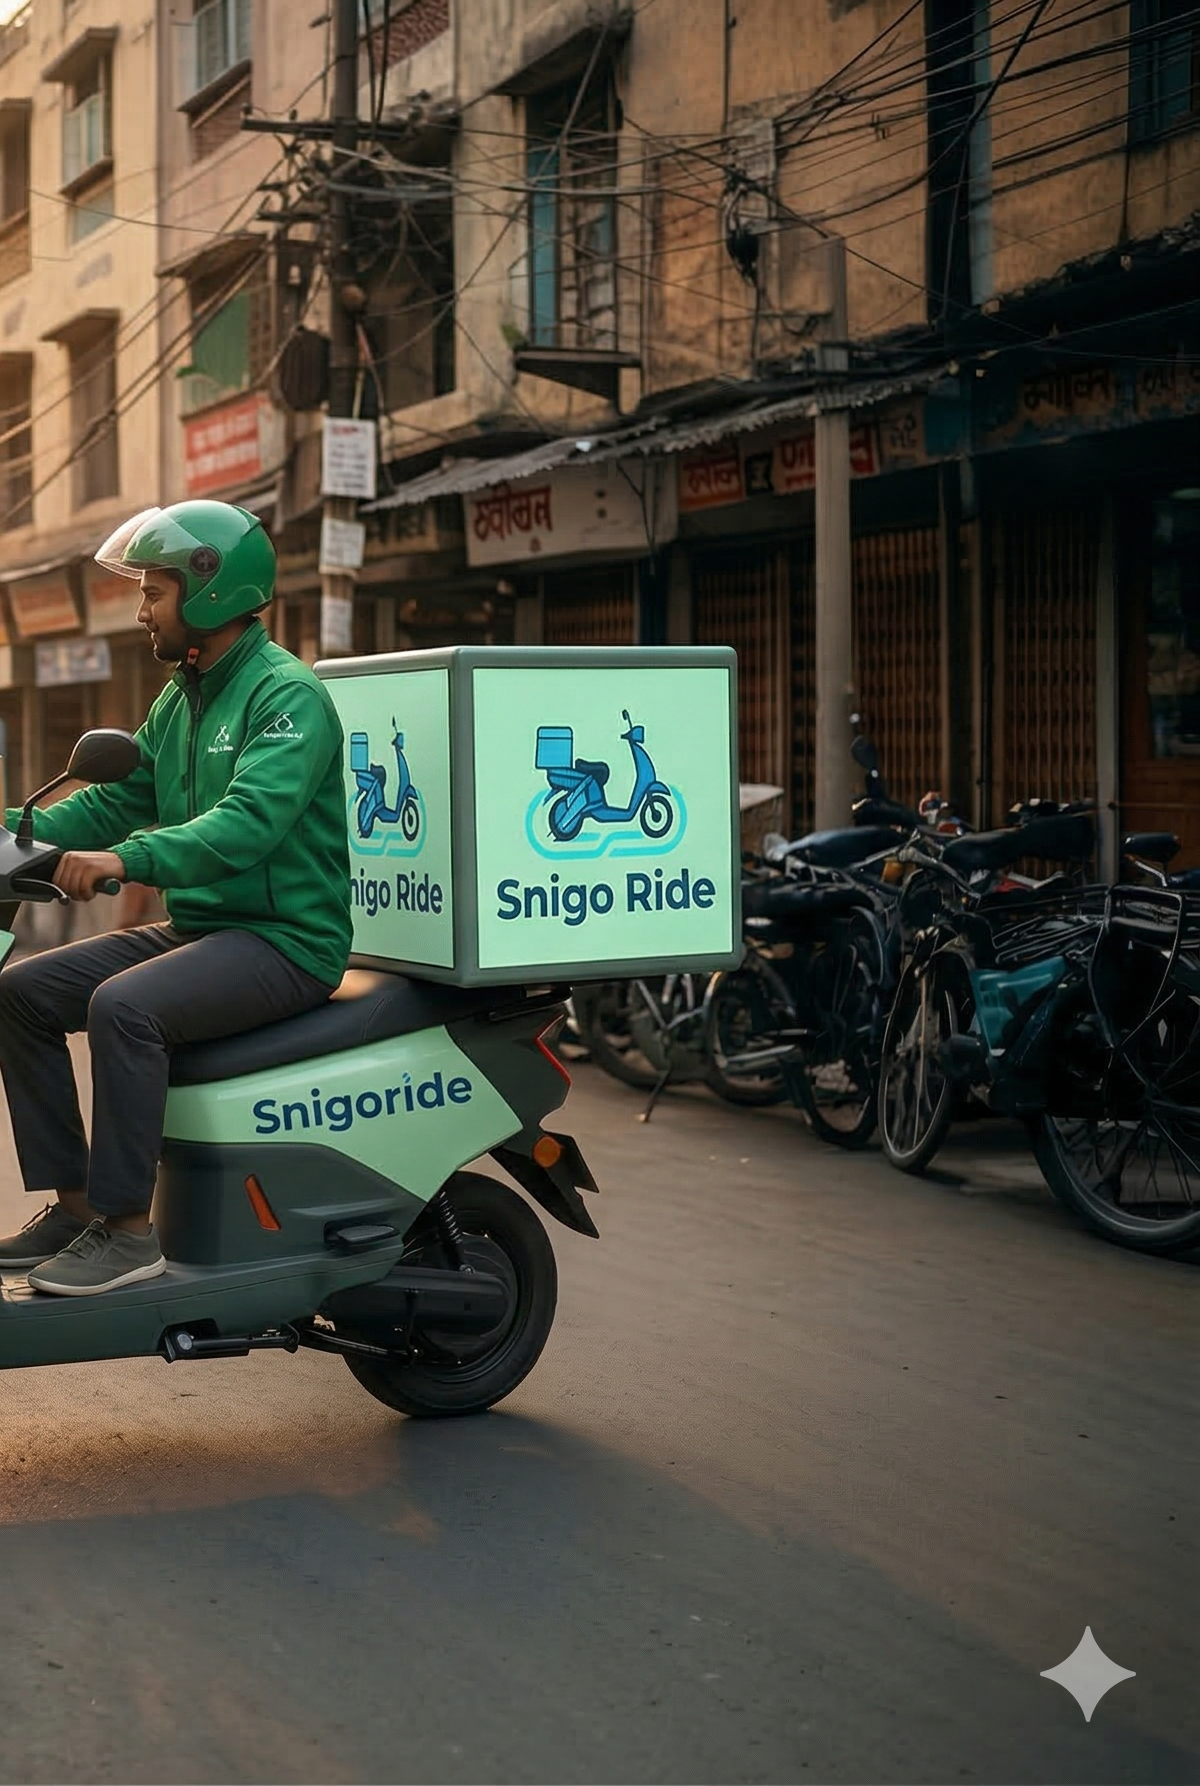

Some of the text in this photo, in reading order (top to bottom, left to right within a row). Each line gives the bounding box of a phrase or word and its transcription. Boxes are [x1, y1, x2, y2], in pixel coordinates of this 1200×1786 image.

[350, 868, 443, 917] nigo Ride
[496, 868, 716, 926] Snigo Ride
[253, 1072, 472, 1134] Snigoride
